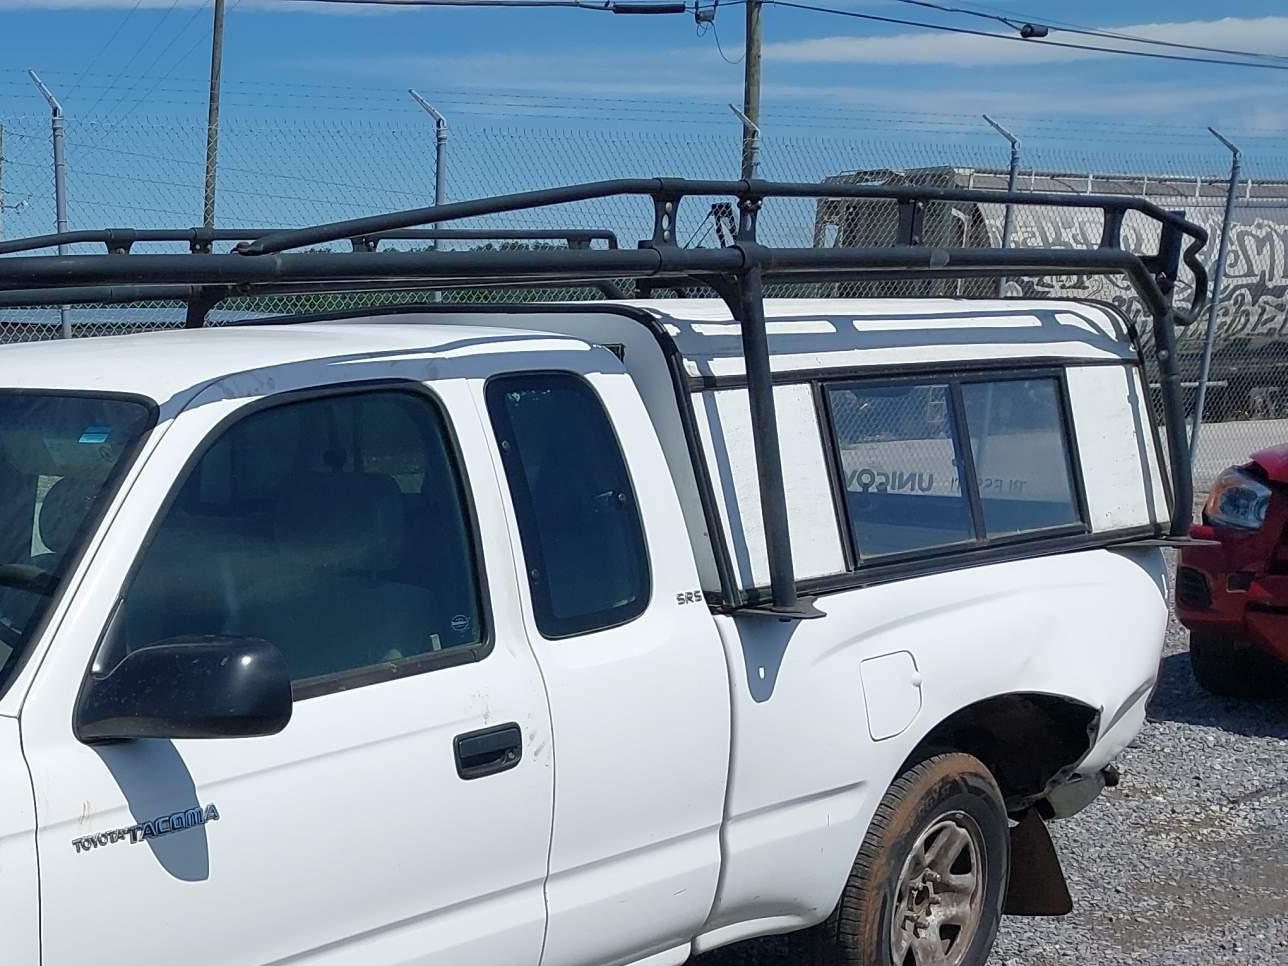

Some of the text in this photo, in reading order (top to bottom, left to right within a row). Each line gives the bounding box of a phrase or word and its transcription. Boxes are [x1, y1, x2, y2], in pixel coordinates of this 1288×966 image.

[676, 590, 702, 605] SRS
[72, 803, 220, 853] TOYOTA TACOMA
